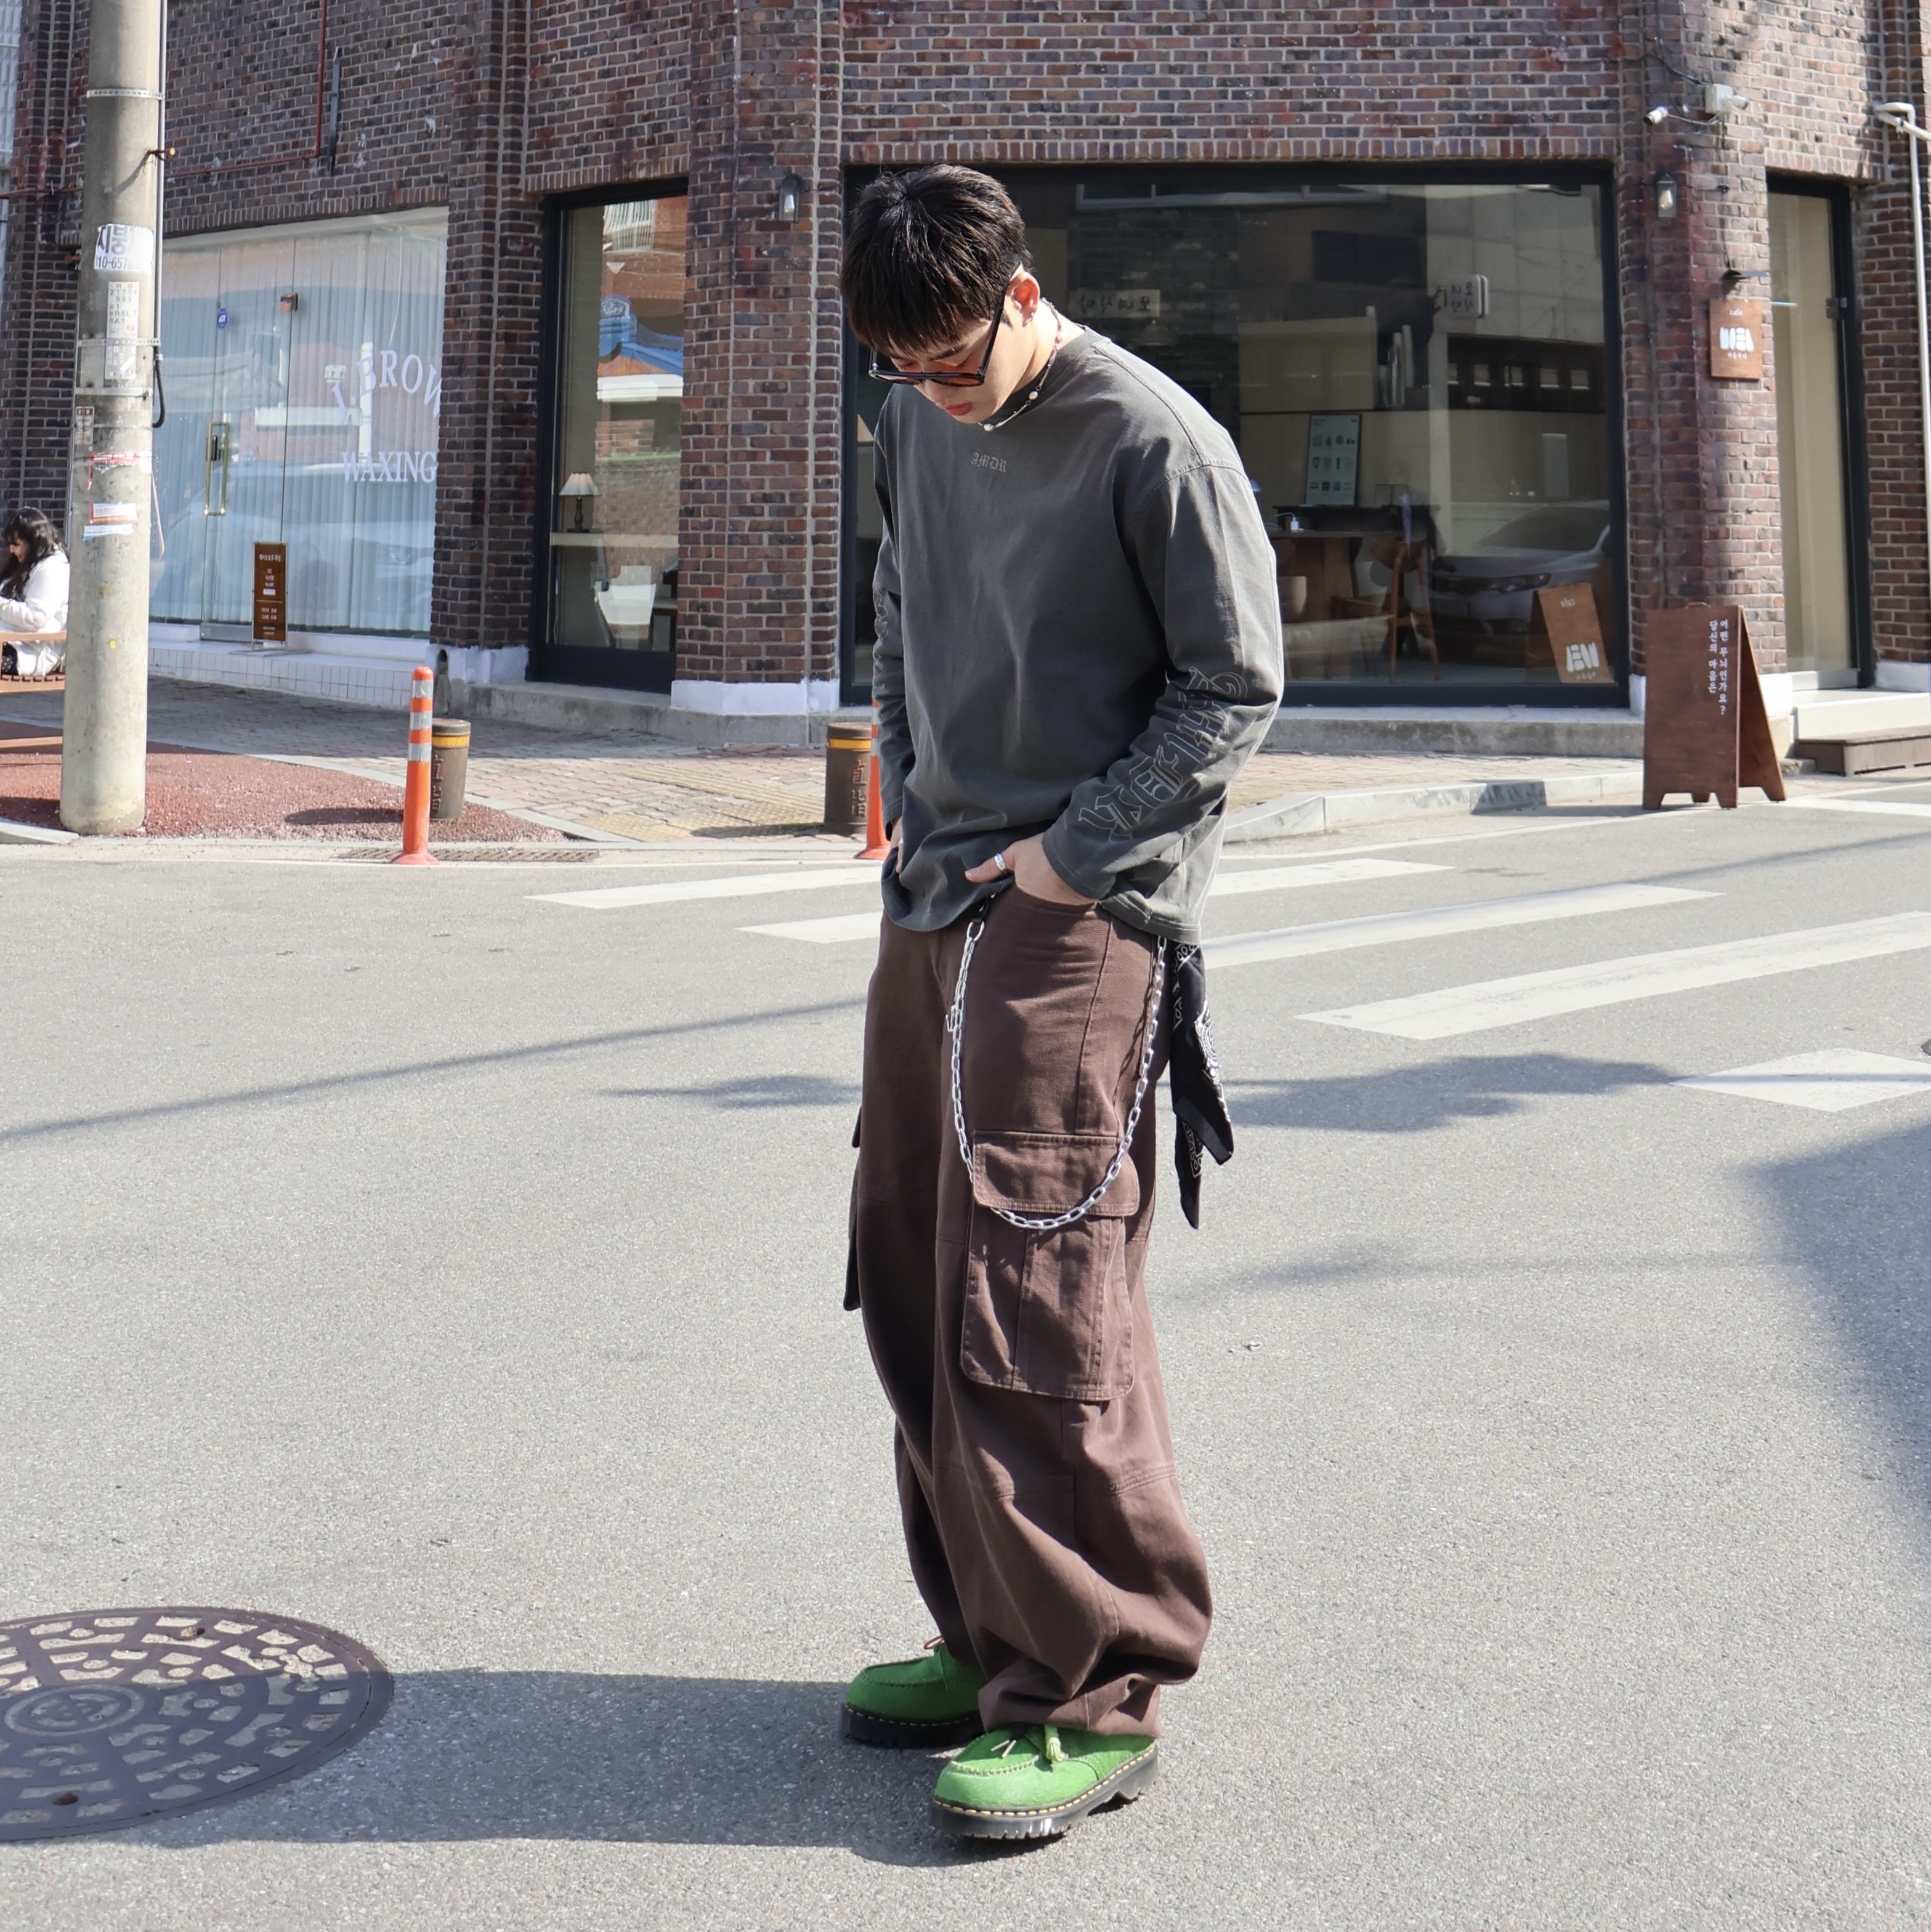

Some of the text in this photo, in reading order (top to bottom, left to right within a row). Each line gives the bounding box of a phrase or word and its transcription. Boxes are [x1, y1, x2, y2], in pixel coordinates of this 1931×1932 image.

[1730, 308, 1743, 316] cafe
[341, 451, 439, 483] WAXING
[1708, 620, 1718, 693] 당신의 마음은
[1718, 619, 1728, 716] 어떤 무늬인가요?
